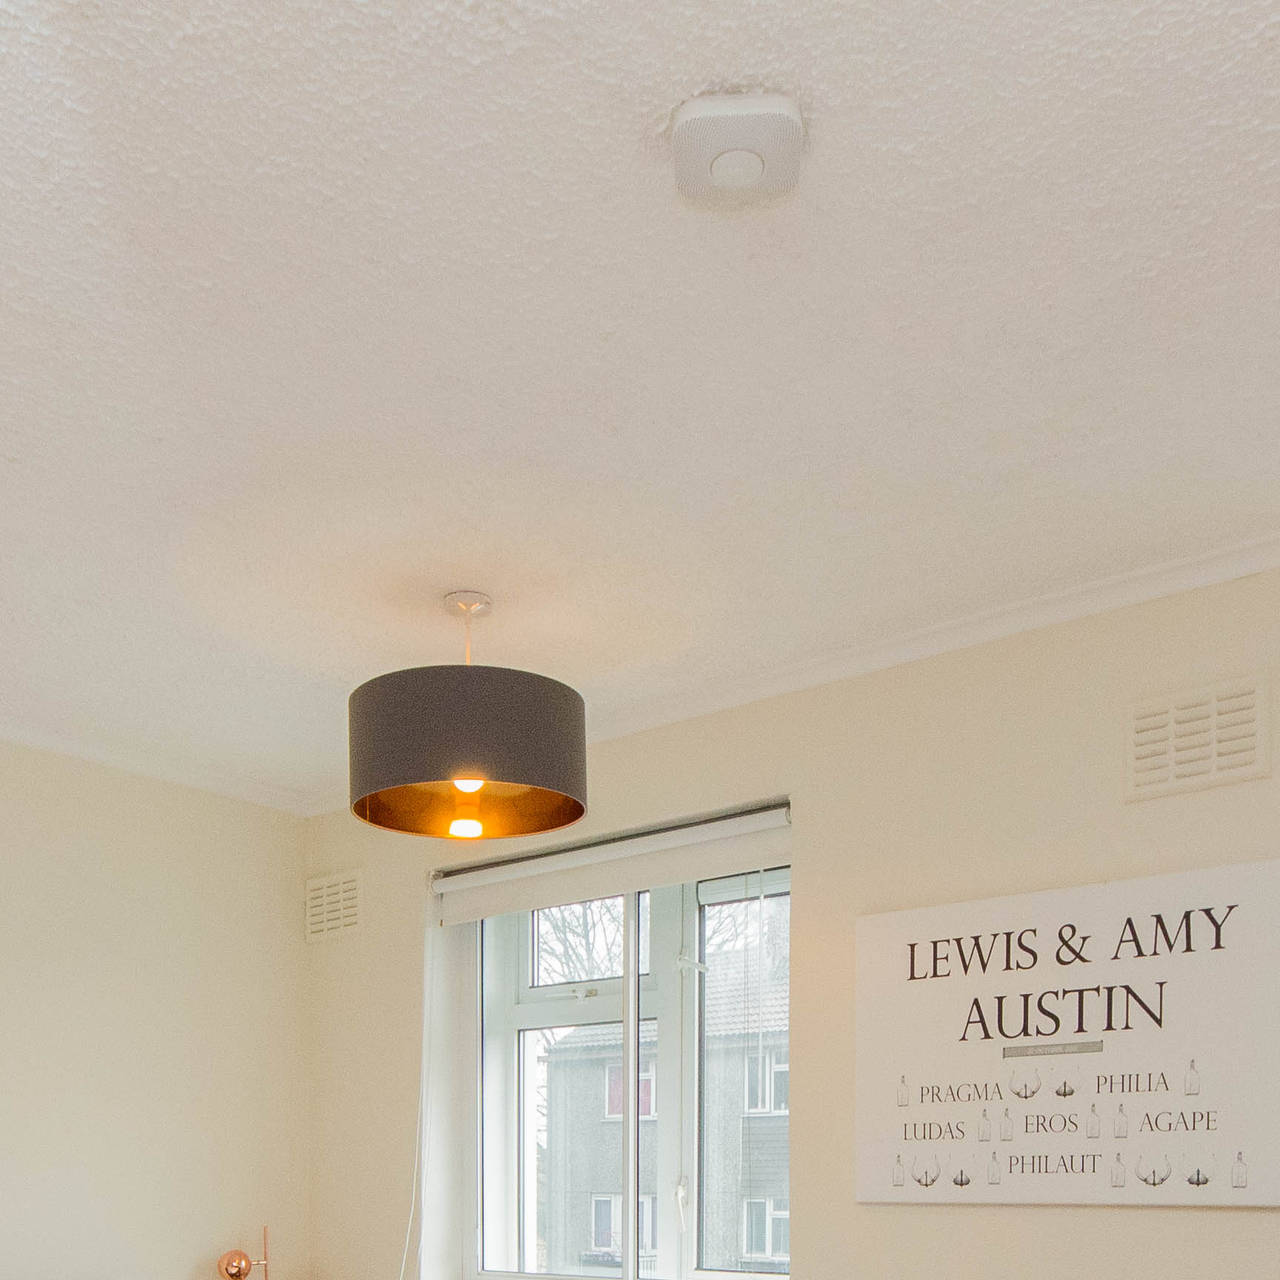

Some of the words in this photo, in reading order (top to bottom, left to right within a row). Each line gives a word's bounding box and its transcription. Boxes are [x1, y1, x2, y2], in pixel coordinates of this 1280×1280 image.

[907, 928, 1038, 981] LEWIS
[1055, 923, 1091, 966] &
[1111, 904, 1239, 960] AMY
[958, 981, 1167, 1042] AUSTIN
[919, 1082, 1003, 1103] PRAGMA
[1095, 1072, 1170, 1094] PHILIA
[903, 1121, 966, 1141] LUDAS
[1024, 1113, 1078, 1133] EROS
[1138, 1110, 1218, 1132] AGAPE
[1008, 1153, 1102, 1174] PHILAUT
